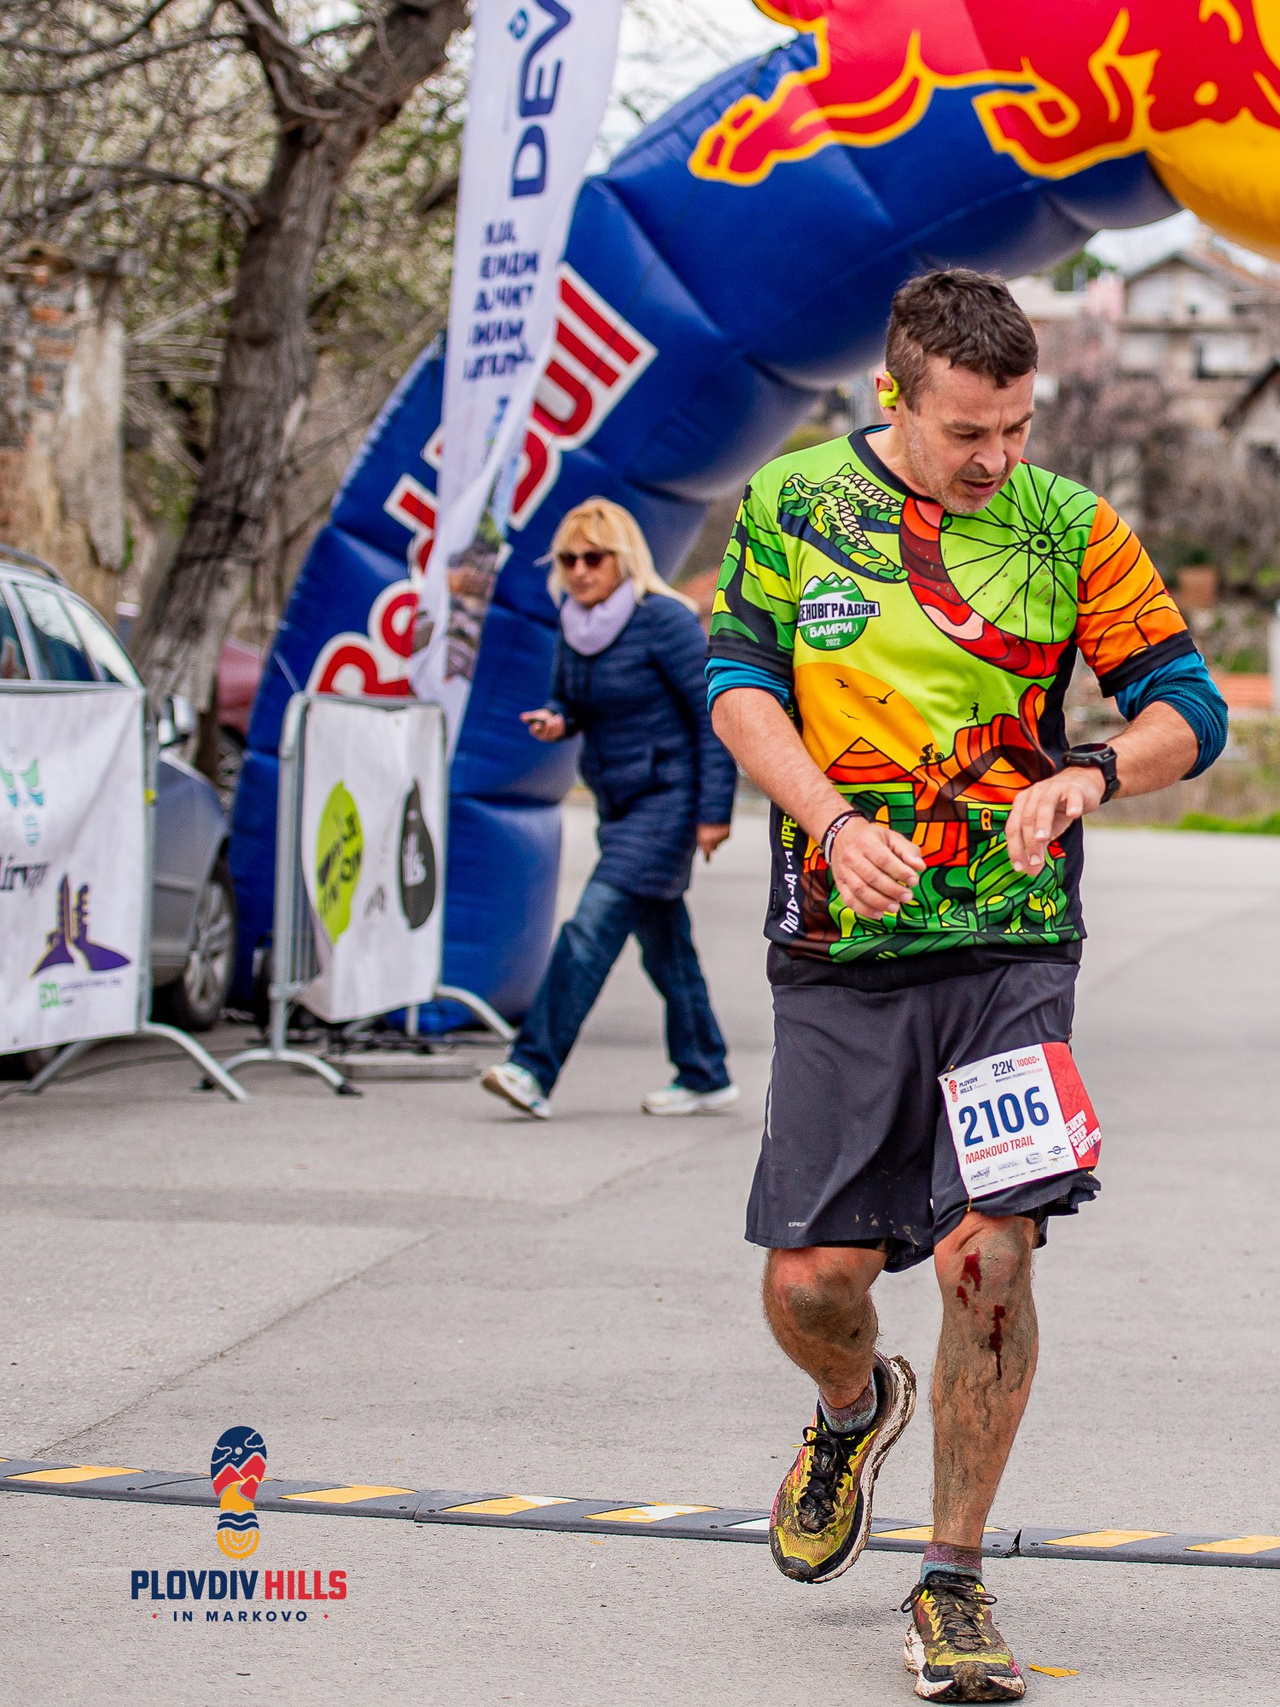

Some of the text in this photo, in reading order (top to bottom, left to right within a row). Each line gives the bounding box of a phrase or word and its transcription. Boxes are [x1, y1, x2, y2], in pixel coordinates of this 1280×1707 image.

[991, 1058, 1015, 1077] 22K
[958, 1086, 1050, 1147] 2106
[965, 1145, 1009, 1165] MARKOVO
[1009, 1135, 1035, 1152] TRAIL
